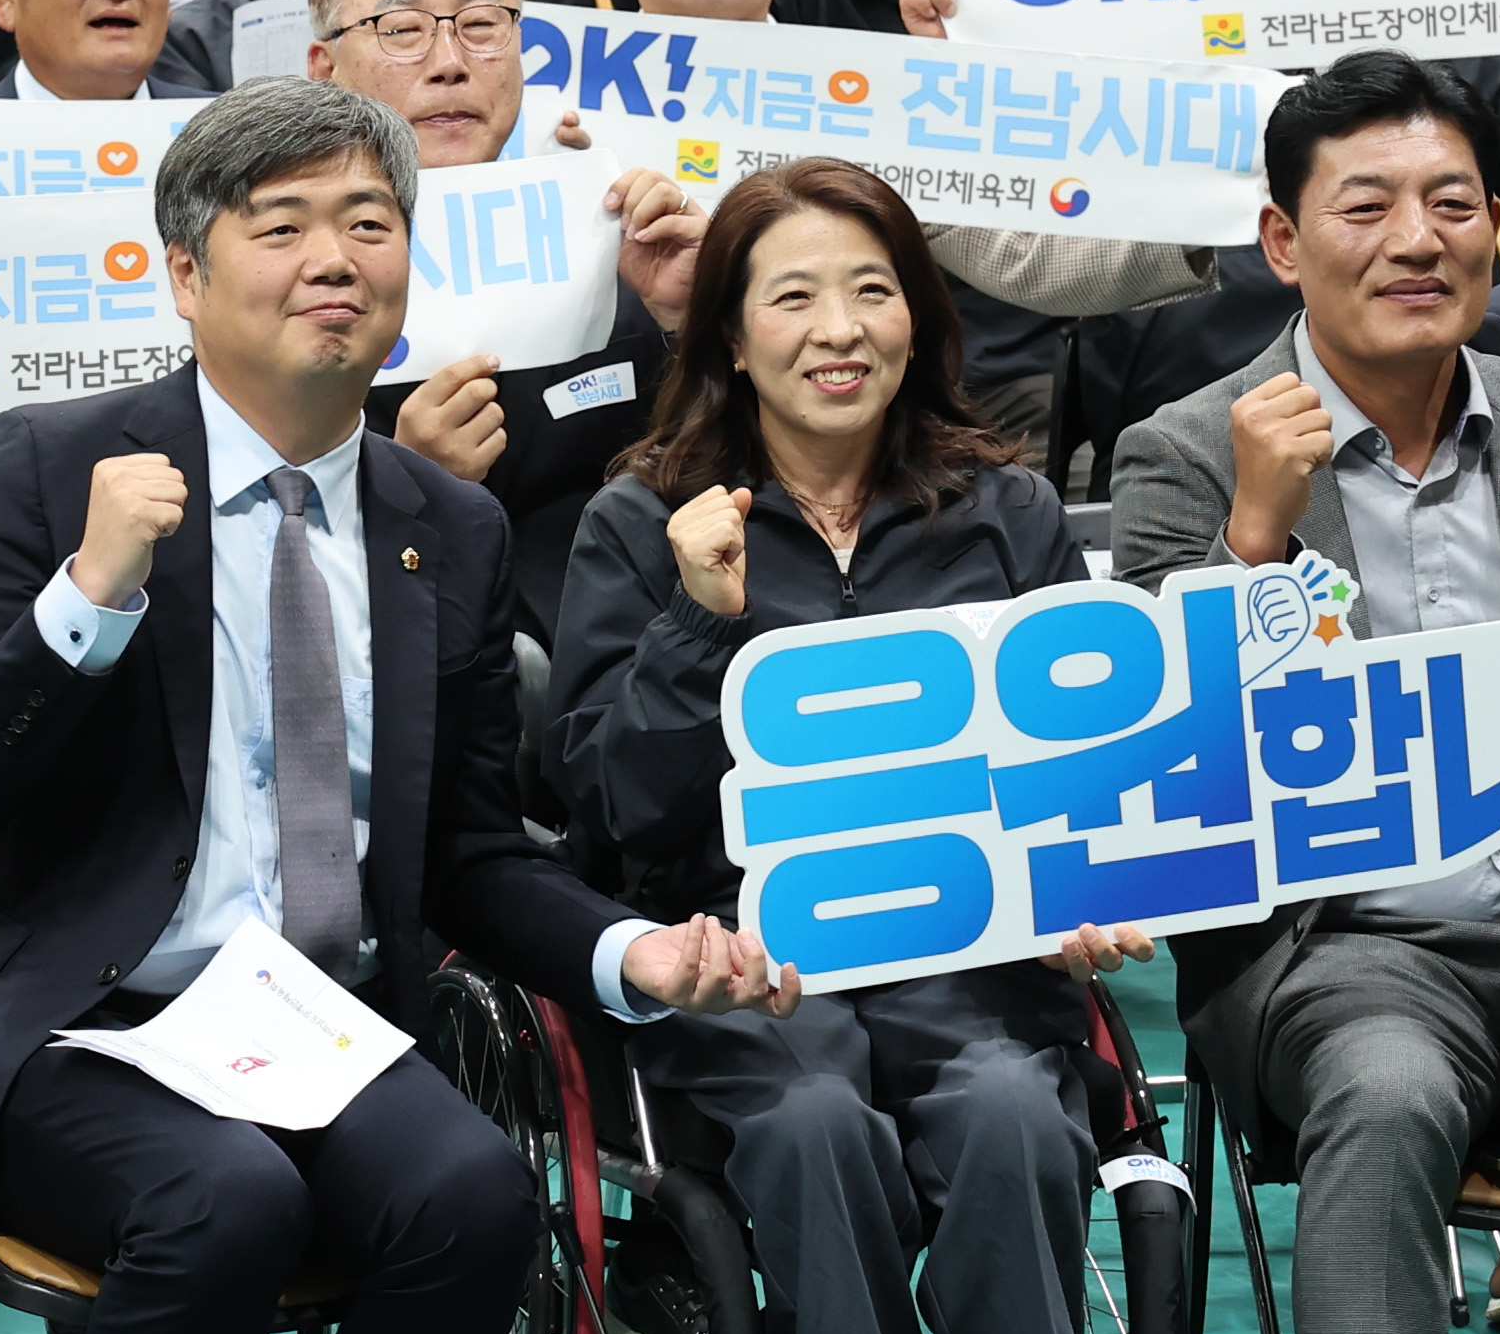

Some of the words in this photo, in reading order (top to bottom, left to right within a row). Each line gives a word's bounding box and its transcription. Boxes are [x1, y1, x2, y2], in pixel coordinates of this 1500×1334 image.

[702, 68, 873, 137] 지금은
[901, 59, 1256, 172] 전남시대
[568, 375, 597, 393] OK!
[573, 383, 622, 407] 전남시대
